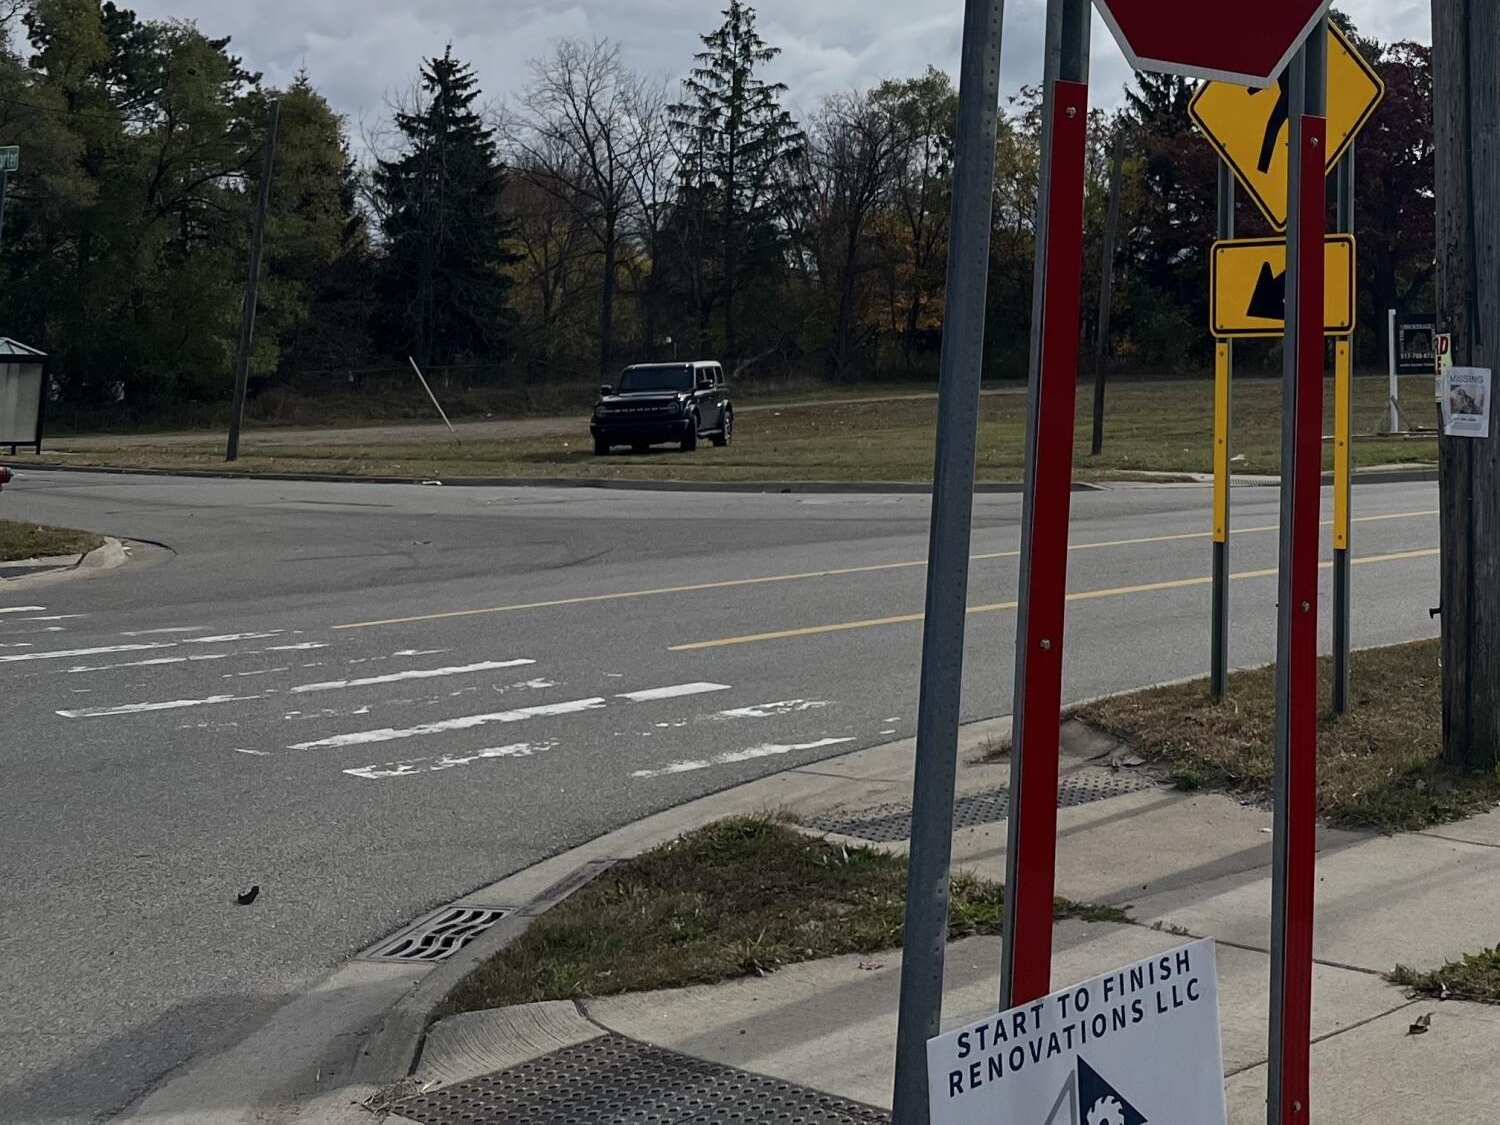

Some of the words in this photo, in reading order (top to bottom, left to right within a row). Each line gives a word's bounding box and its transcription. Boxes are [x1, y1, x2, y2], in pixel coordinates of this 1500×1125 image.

[948, 999, 1144, 1098] RENOVATIONS
[1156, 978, 1200, 1014] LLC
[957, 1003, 1045, 1059] START
[1057, 987, 1090, 1019] TO
[1102, 949, 1191, 1003] FINISH
